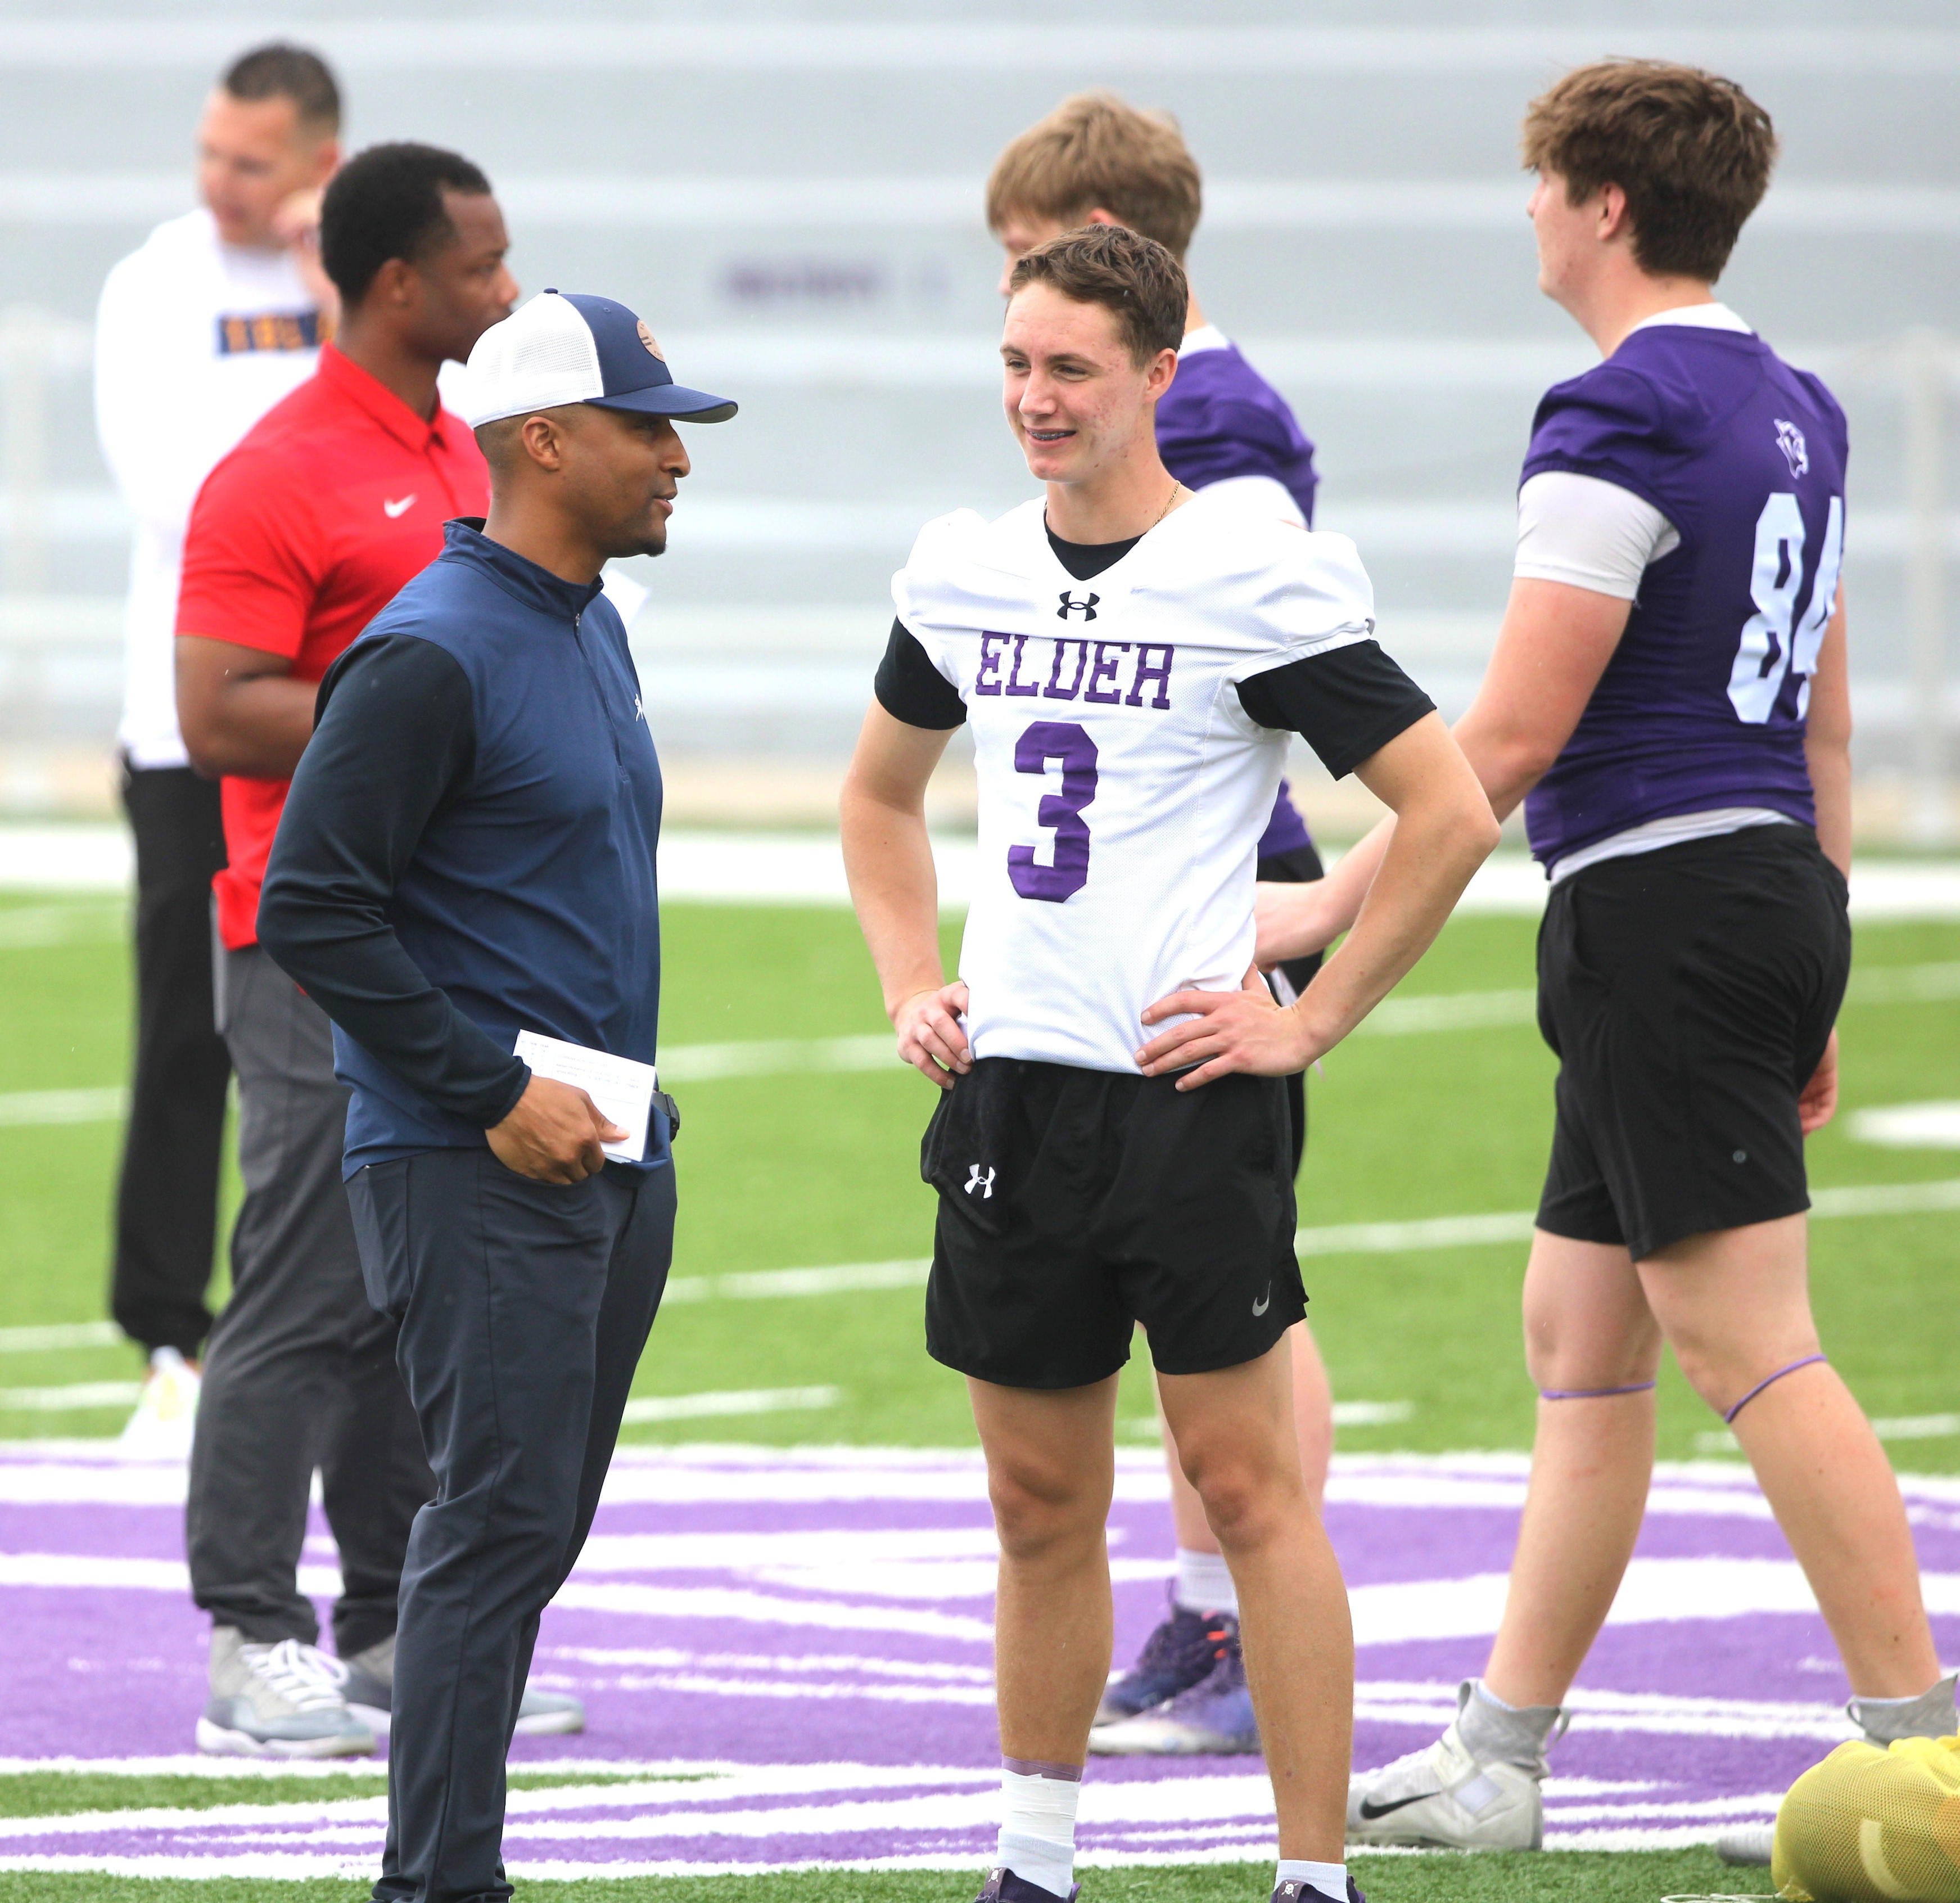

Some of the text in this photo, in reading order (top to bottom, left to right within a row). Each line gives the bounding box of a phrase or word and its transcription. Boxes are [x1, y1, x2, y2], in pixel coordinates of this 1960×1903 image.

[976, 630, 1175, 709] ELDER
[1727, 492, 1842, 724] 84
[1008, 721, 1098, 903] 3
